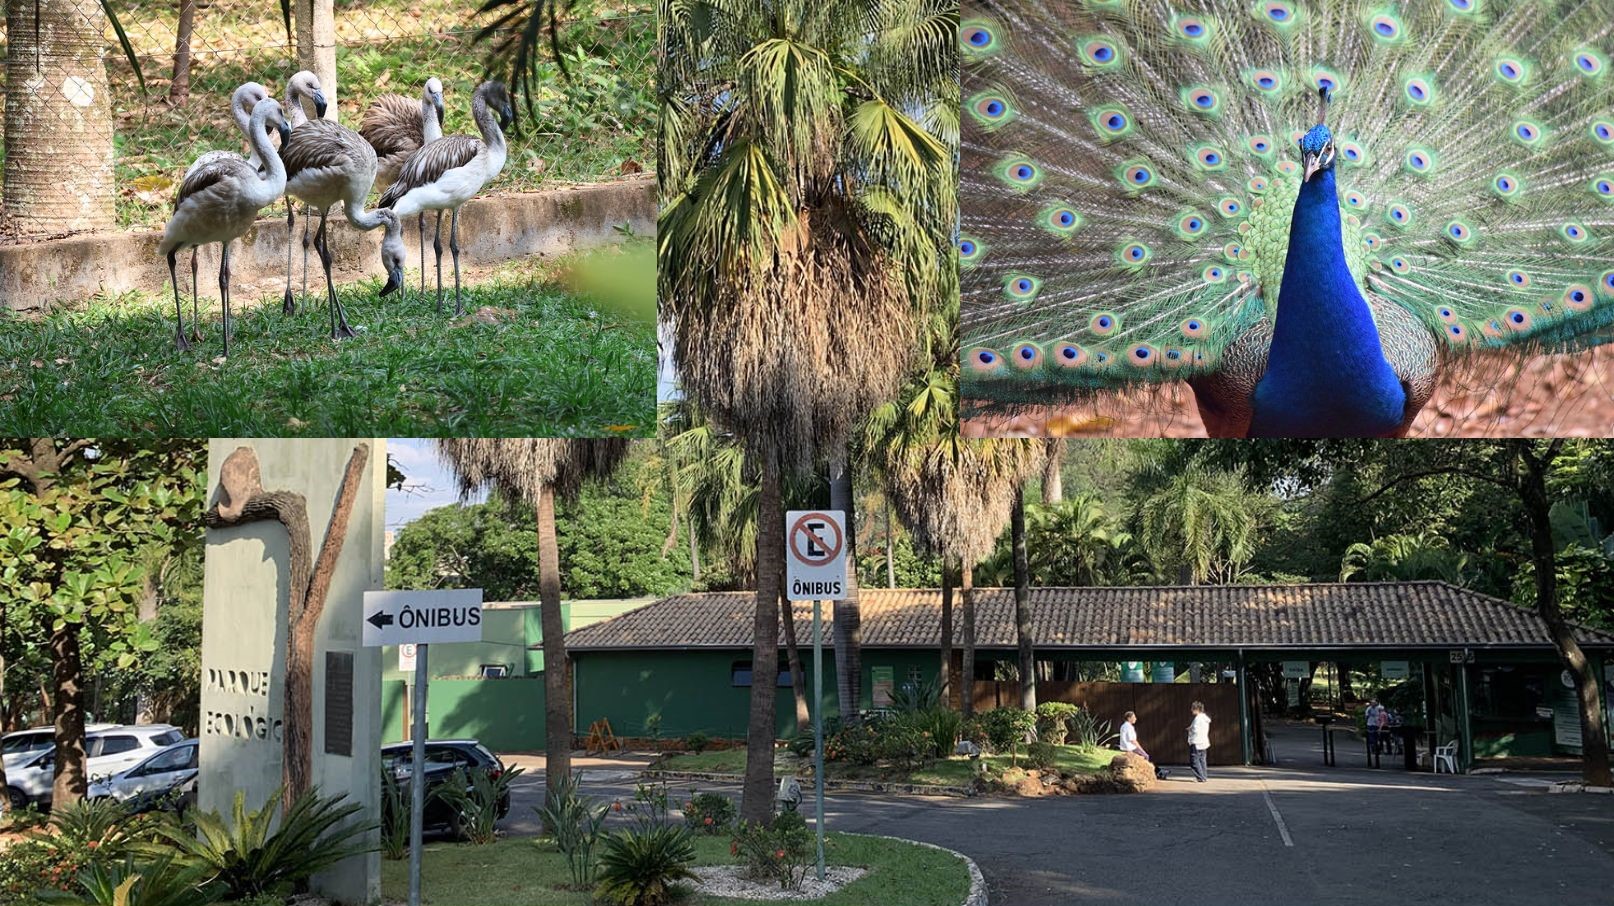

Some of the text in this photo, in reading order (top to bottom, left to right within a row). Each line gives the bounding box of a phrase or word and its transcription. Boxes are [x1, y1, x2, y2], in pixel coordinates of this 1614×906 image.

[793, 579, 841, 595] ÔNIBUS
[399, 604, 481, 629] ÔNIBUS
[207, 668, 268, 697] PARQUE
[206, 705, 283, 743] ECOLÓGIC
